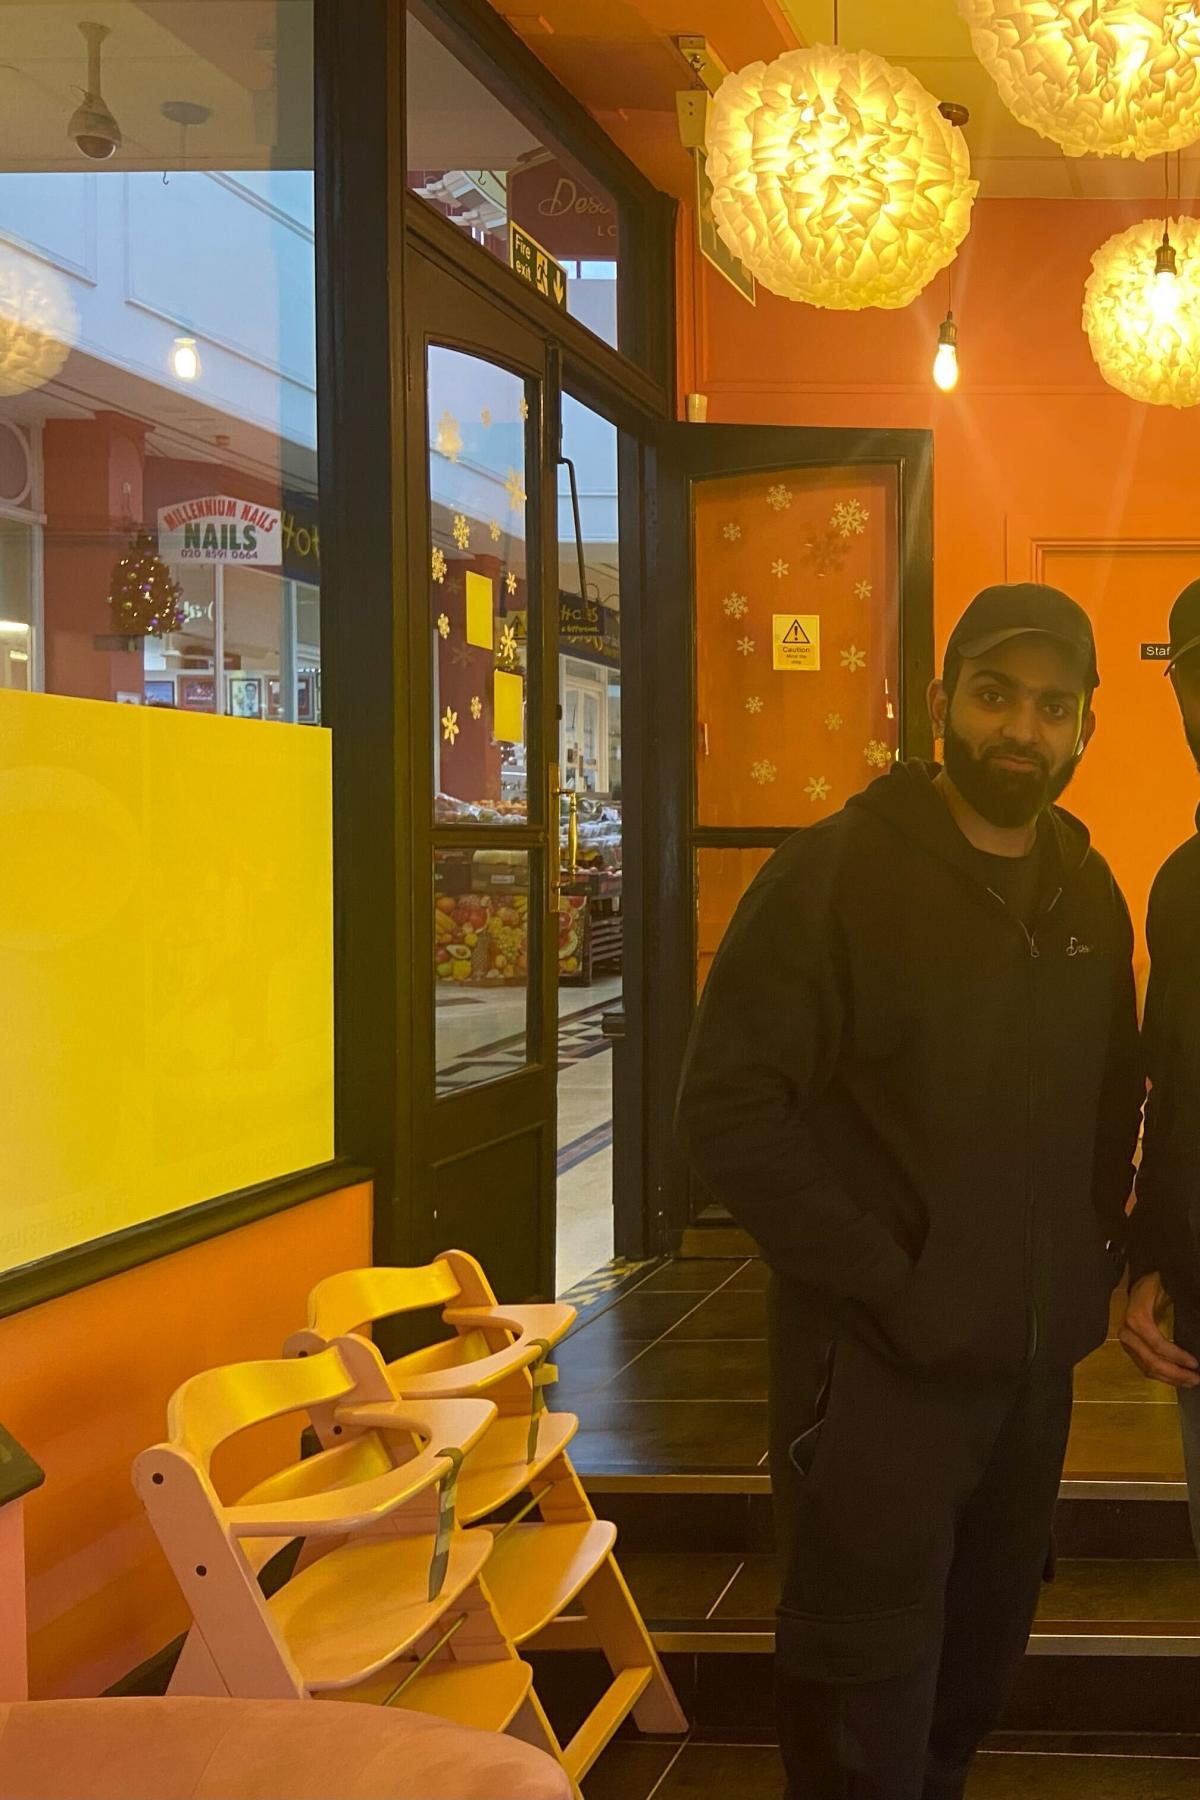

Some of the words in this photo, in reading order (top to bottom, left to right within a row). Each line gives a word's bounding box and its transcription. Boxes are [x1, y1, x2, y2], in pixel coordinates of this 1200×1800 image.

[515, 233, 531, 260] Fire
[515, 260, 532, 282] exit
[163, 500, 237, 532] MILLENNIUM
[240, 503, 278, 533] NAILS
[184, 522, 257, 551] NAILS
[181, 549, 201, 559] 020
[205, 550, 227, 559] 8591
[231, 550, 259, 560] 0664
